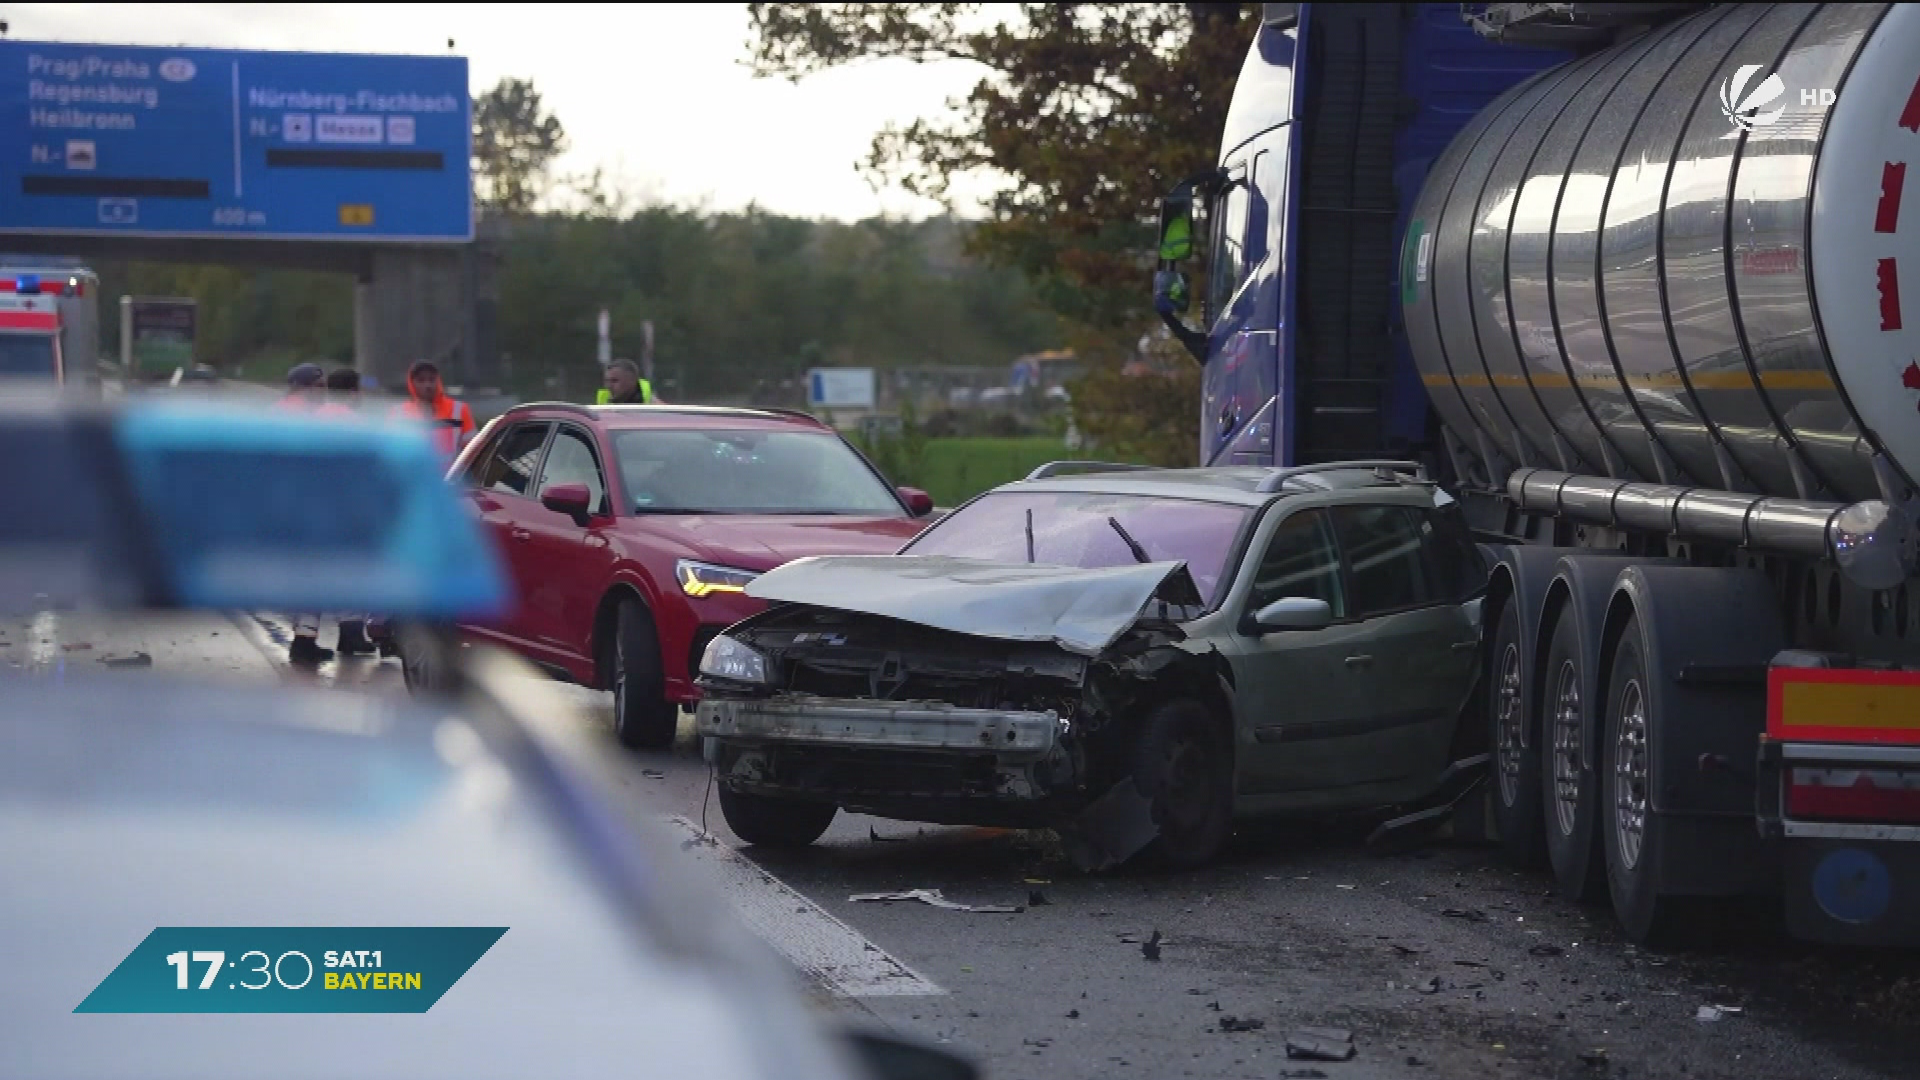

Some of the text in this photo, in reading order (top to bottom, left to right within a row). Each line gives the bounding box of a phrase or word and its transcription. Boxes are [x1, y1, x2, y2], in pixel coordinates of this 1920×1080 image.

[28, 54, 150, 81] Prag/Praha
[29, 79, 158, 109] Regensburg
[30, 107, 136, 130] Heilbronn
